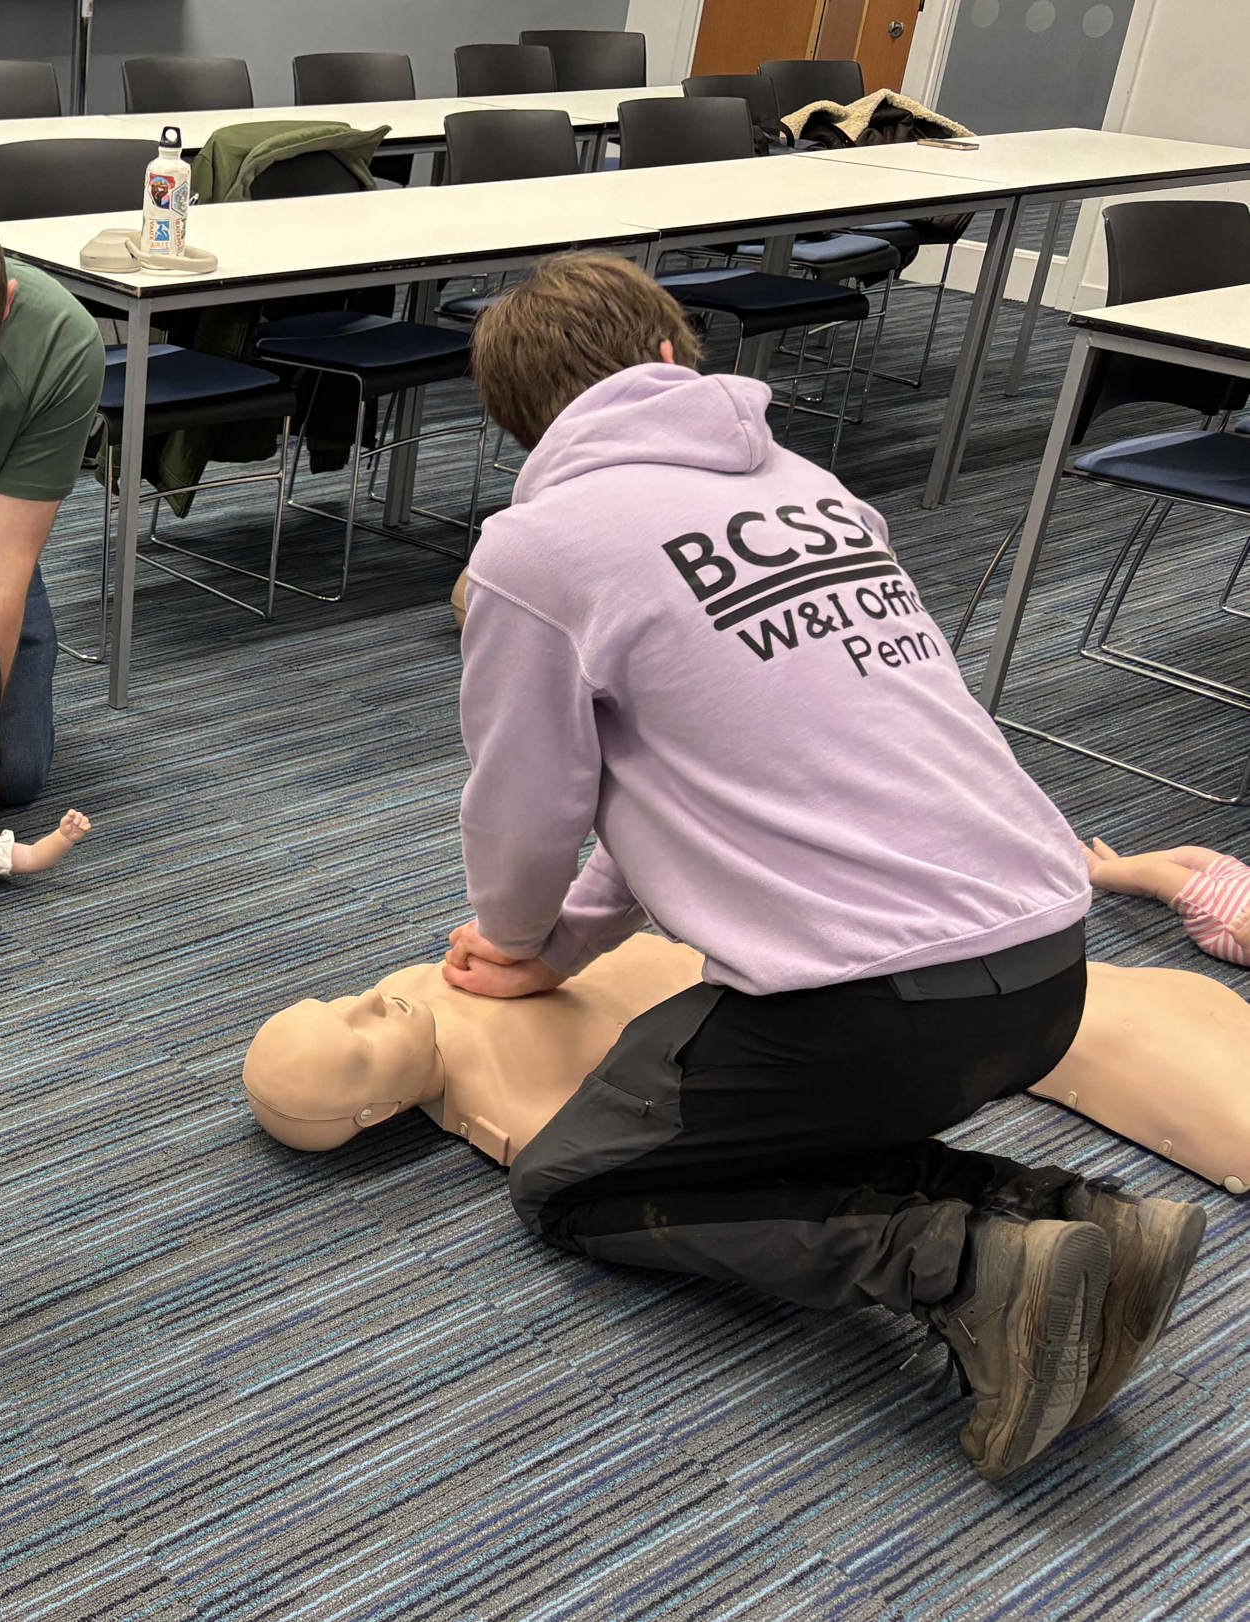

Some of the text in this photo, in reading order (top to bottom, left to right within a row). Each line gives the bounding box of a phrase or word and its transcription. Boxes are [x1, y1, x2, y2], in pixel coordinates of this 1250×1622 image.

[661, 498, 874, 602] BCSS
[736, 592, 854, 662] W&I
[841, 631, 941, 678] Penn
